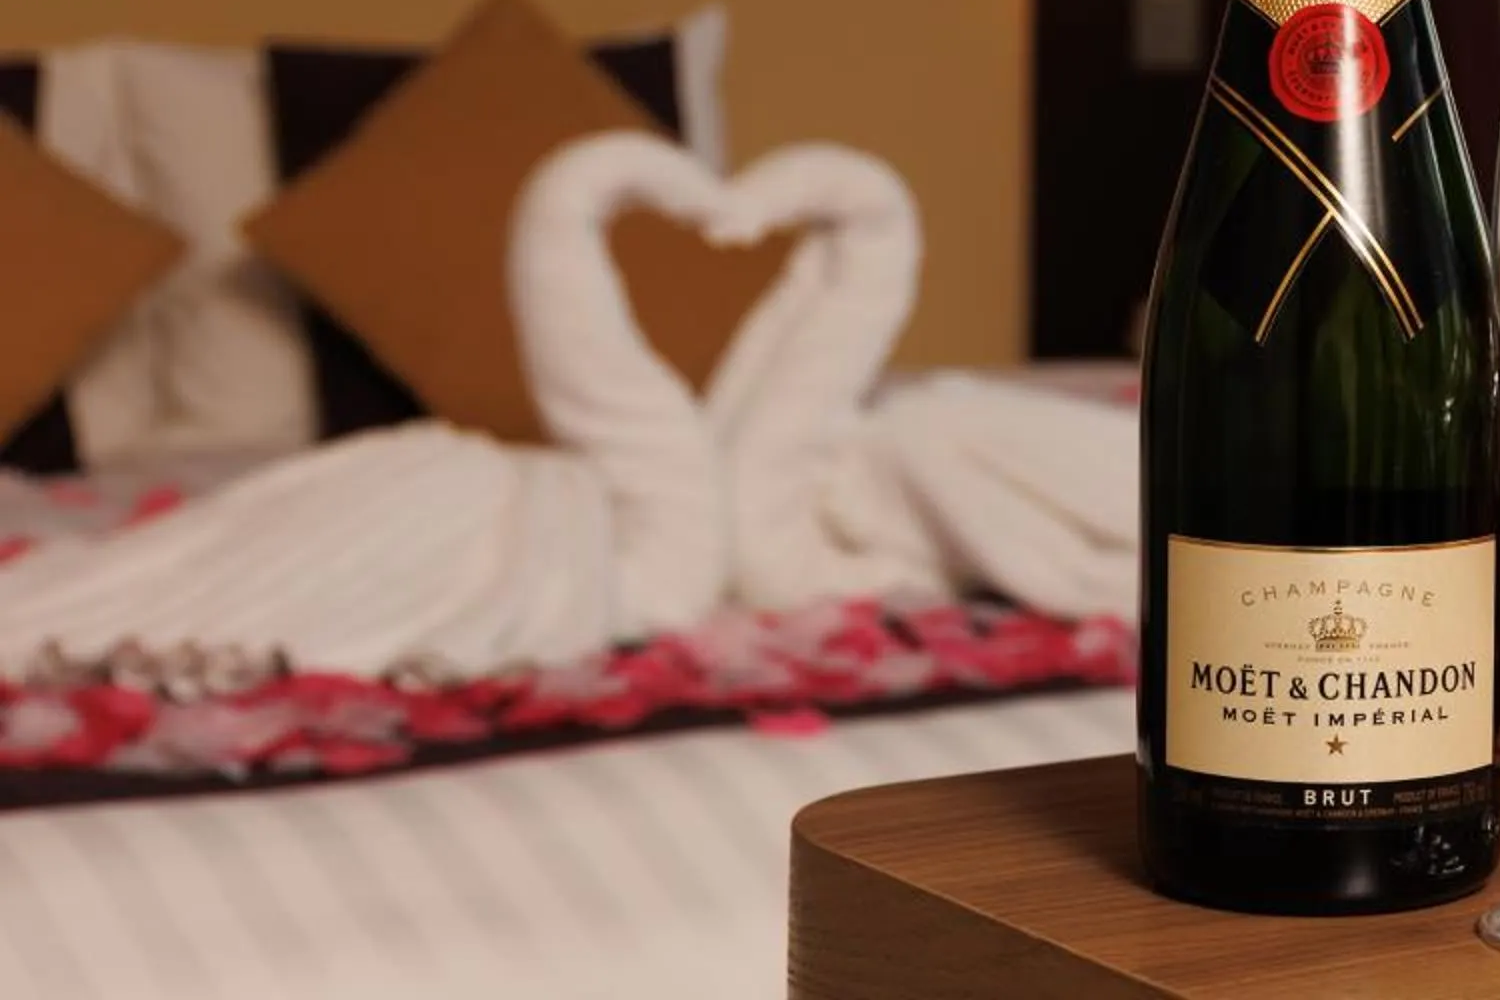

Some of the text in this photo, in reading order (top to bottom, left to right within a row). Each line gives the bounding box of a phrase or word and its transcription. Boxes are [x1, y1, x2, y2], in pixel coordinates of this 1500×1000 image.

[1240, 578, 1437, 608] CHAMPAGNE
[1190, 660, 1477, 701] MOËT & CHANDON
[1222, 705, 1450, 728] MOËT IMPÉRIAL
[1304, 787, 1373, 806] BRUT
